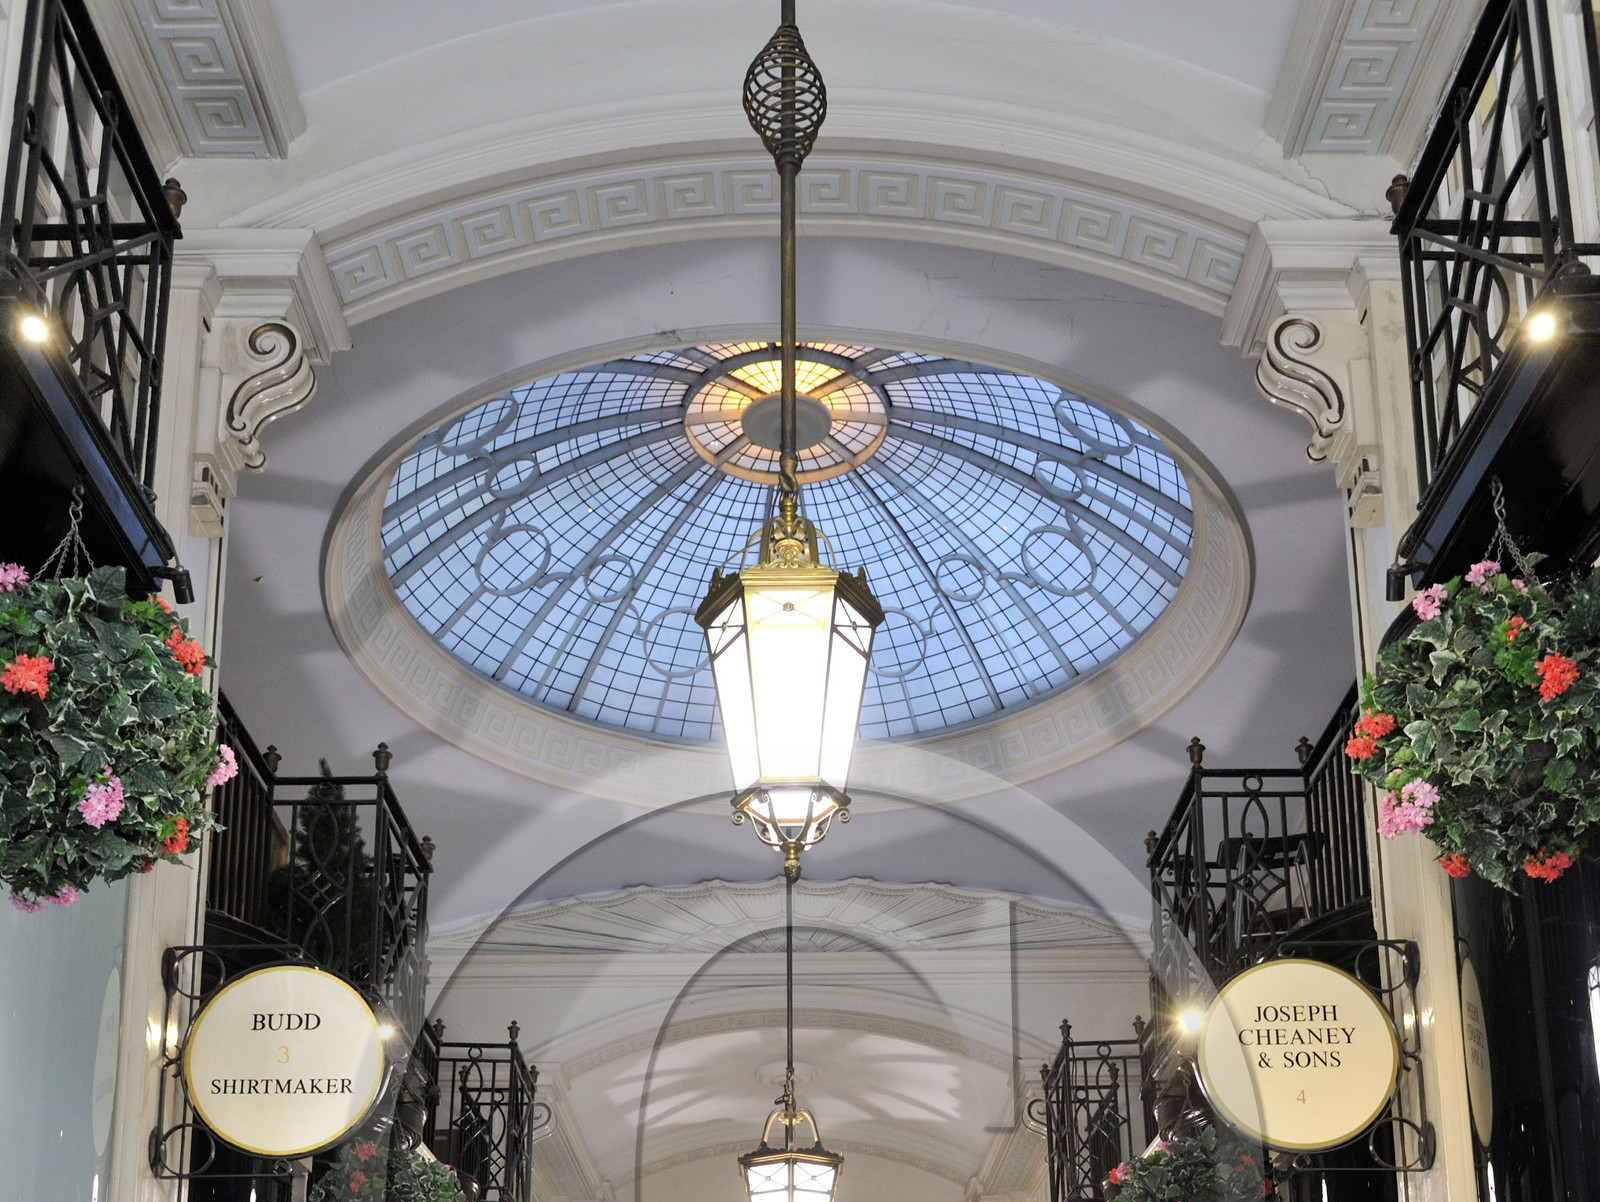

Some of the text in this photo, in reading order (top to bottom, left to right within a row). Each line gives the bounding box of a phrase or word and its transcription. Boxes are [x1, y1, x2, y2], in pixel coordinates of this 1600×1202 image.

[251, 1013, 321, 1031] BUDD
[1254, 1004, 1338, 1023] JOSEPH
[1238, 1027, 1356, 1046] CHEANEY
[277, 1045, 290, 1064] 3
[1258, 1051, 1341, 1069] & SONS
[210, 1078, 354, 1095] SHIRTMAKER
[1296, 1089, 1308, 1105] 4
